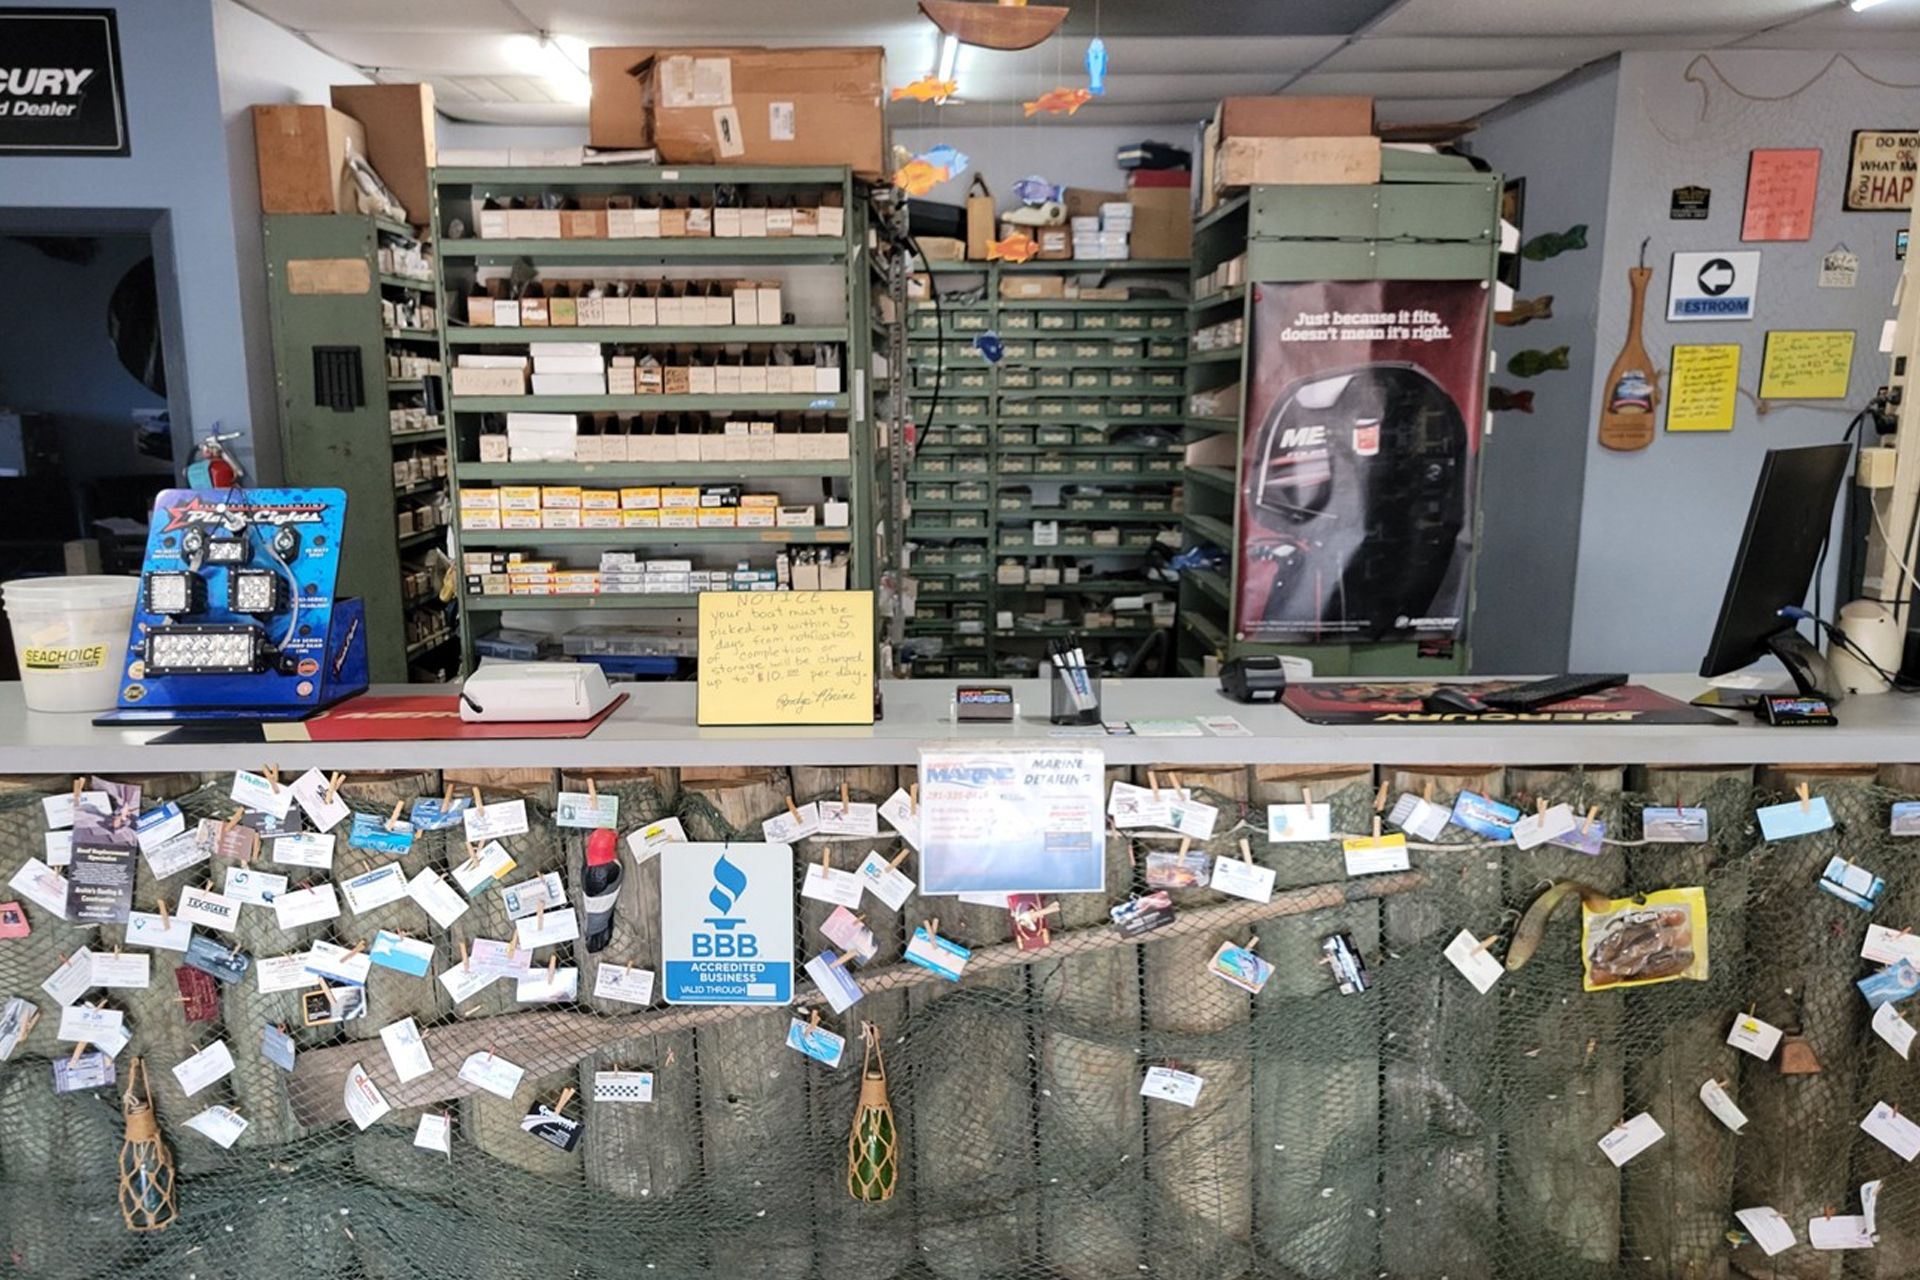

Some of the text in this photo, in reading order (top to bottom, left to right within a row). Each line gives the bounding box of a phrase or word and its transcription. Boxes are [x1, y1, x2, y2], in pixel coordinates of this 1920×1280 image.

[13, 101, 77, 116] Dealer
[1876, 136, 1895, 148] DO
[1861, 161, 1897, 171] WHAT
[1858, 174, 1870, 201] YOU
[1675, 299, 1749, 314] RESTROOM
[1294, 310, 1441, 326] Just because it fits,
[1281, 325, 1452, 342] doesn't mean it's right.
[736, 592, 821, 607] NOTICE
[751, 606, 783, 619] boat
[789, 606, 824, 617] must
[830, 605, 848, 614] be
[709, 622, 754, 640] picked
[761, 624, 779, 633] up
[787, 619, 831, 630] within
[715, 638, 745, 655] days
[753, 635, 784, 646] from
[26, 646, 103, 662] SEACHOICE
[707, 652, 721, 665] of
[711, 661, 765, 676] storage
[795, 656, 809, 666] be
[817, 651, 864, 668] charged
[706, 678, 723, 690] up
[731, 676, 749, 684] to
[809, 669, 831, 683] per
[1031, 758, 1085, 769] MARINE
[692, 933, 758, 957] BBB
[691, 963, 765, 972] ACCREDITED
[700, 973, 757, 982] BUSINESS
[680, 985, 746, 994] VALID THROUGH
